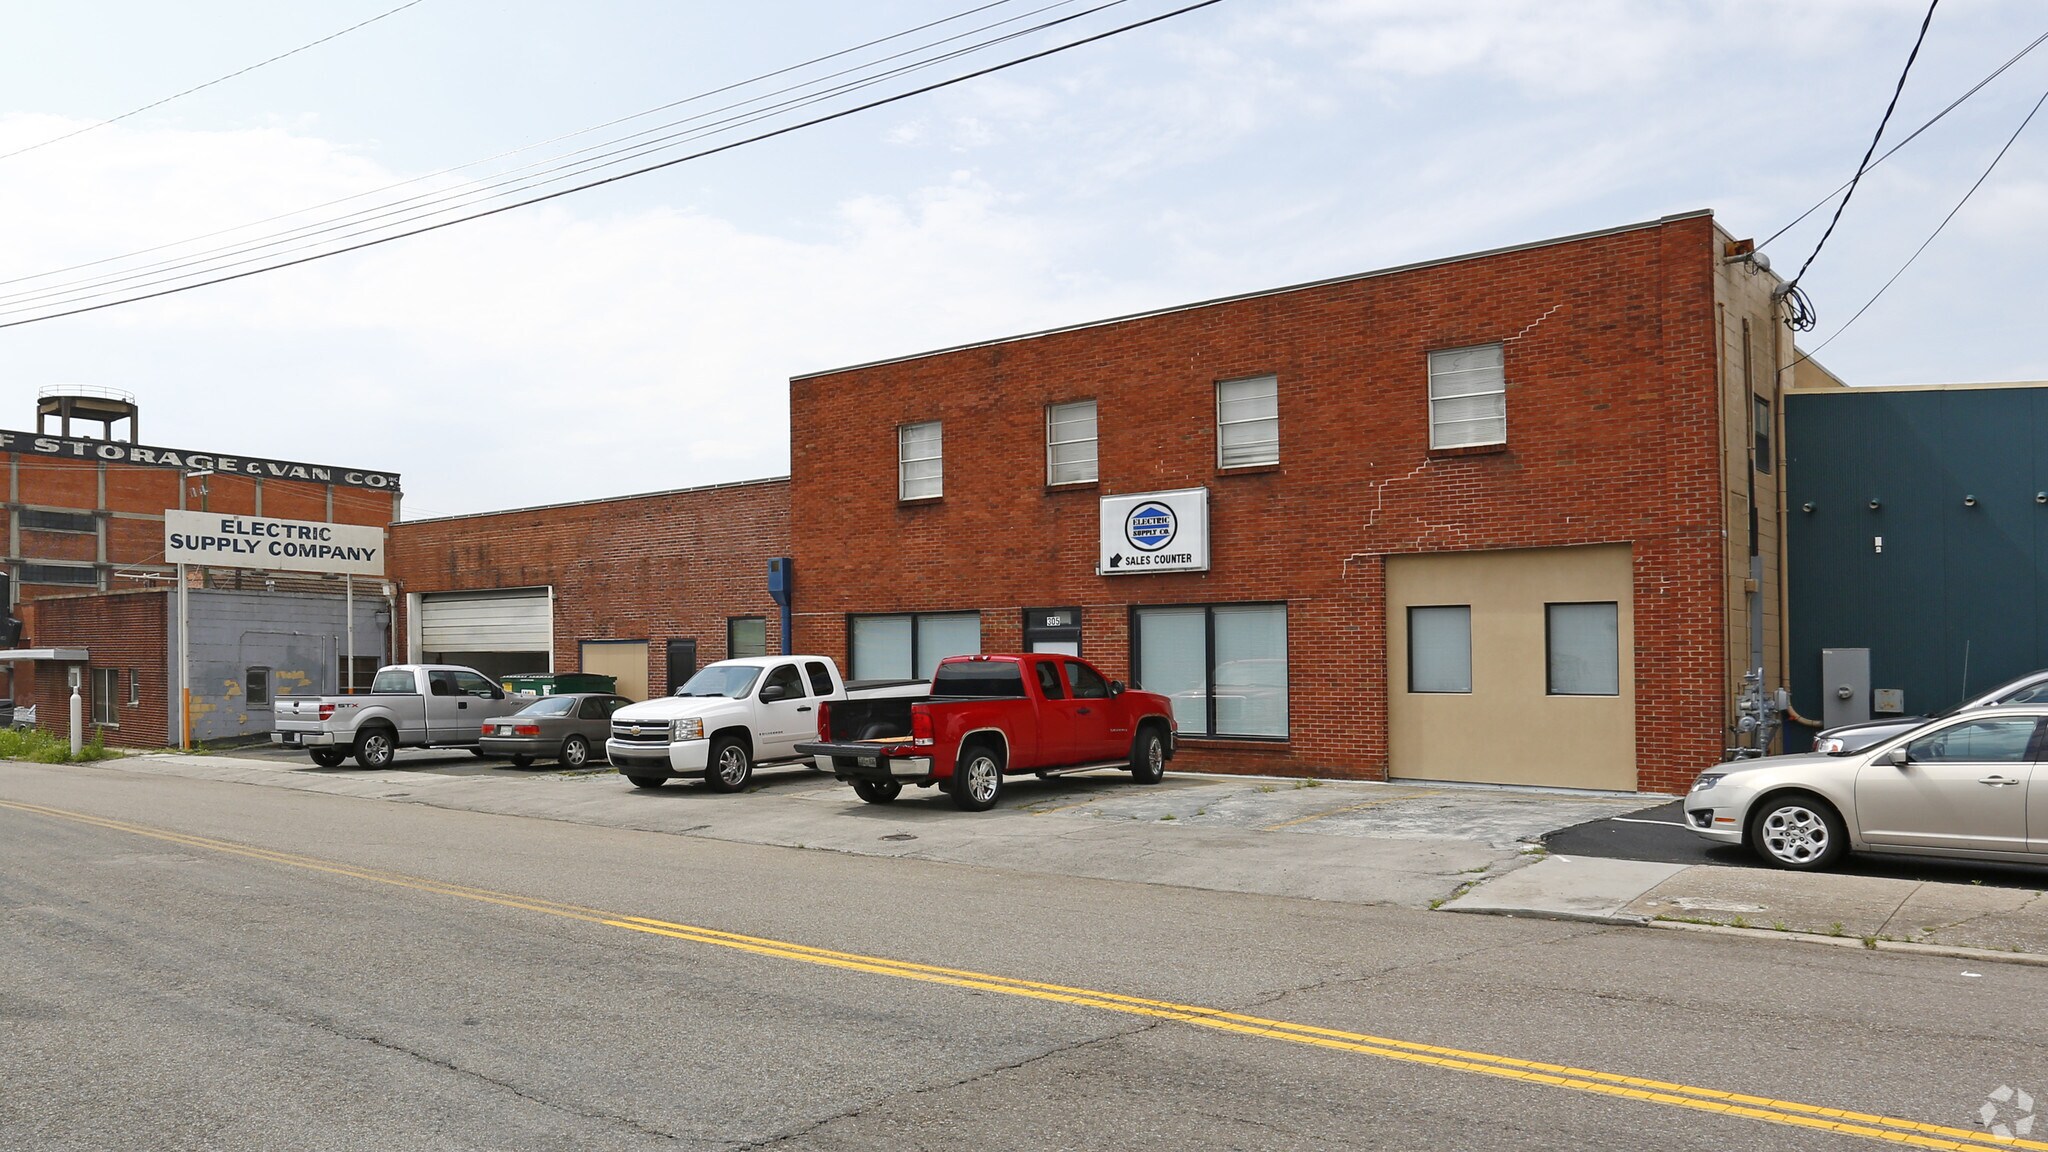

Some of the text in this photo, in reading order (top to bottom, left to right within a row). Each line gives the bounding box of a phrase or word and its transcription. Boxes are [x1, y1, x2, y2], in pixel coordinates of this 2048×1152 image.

[34, 438, 237, 472] STORAGE
[246, 462, 262, 474] &
[267, 463, 331, 481] VAN
[1133, 516, 1170, 526] ELECTRIC
[221, 519, 331, 541] ELECTRIC
[1133, 529, 1157, 537] SUPPLY
[170, 533, 376, 562] SUPPLY COMPANY
[1125, 553, 1192, 566] SALES COUNTER
[1047, 617, 1060, 626] 305
